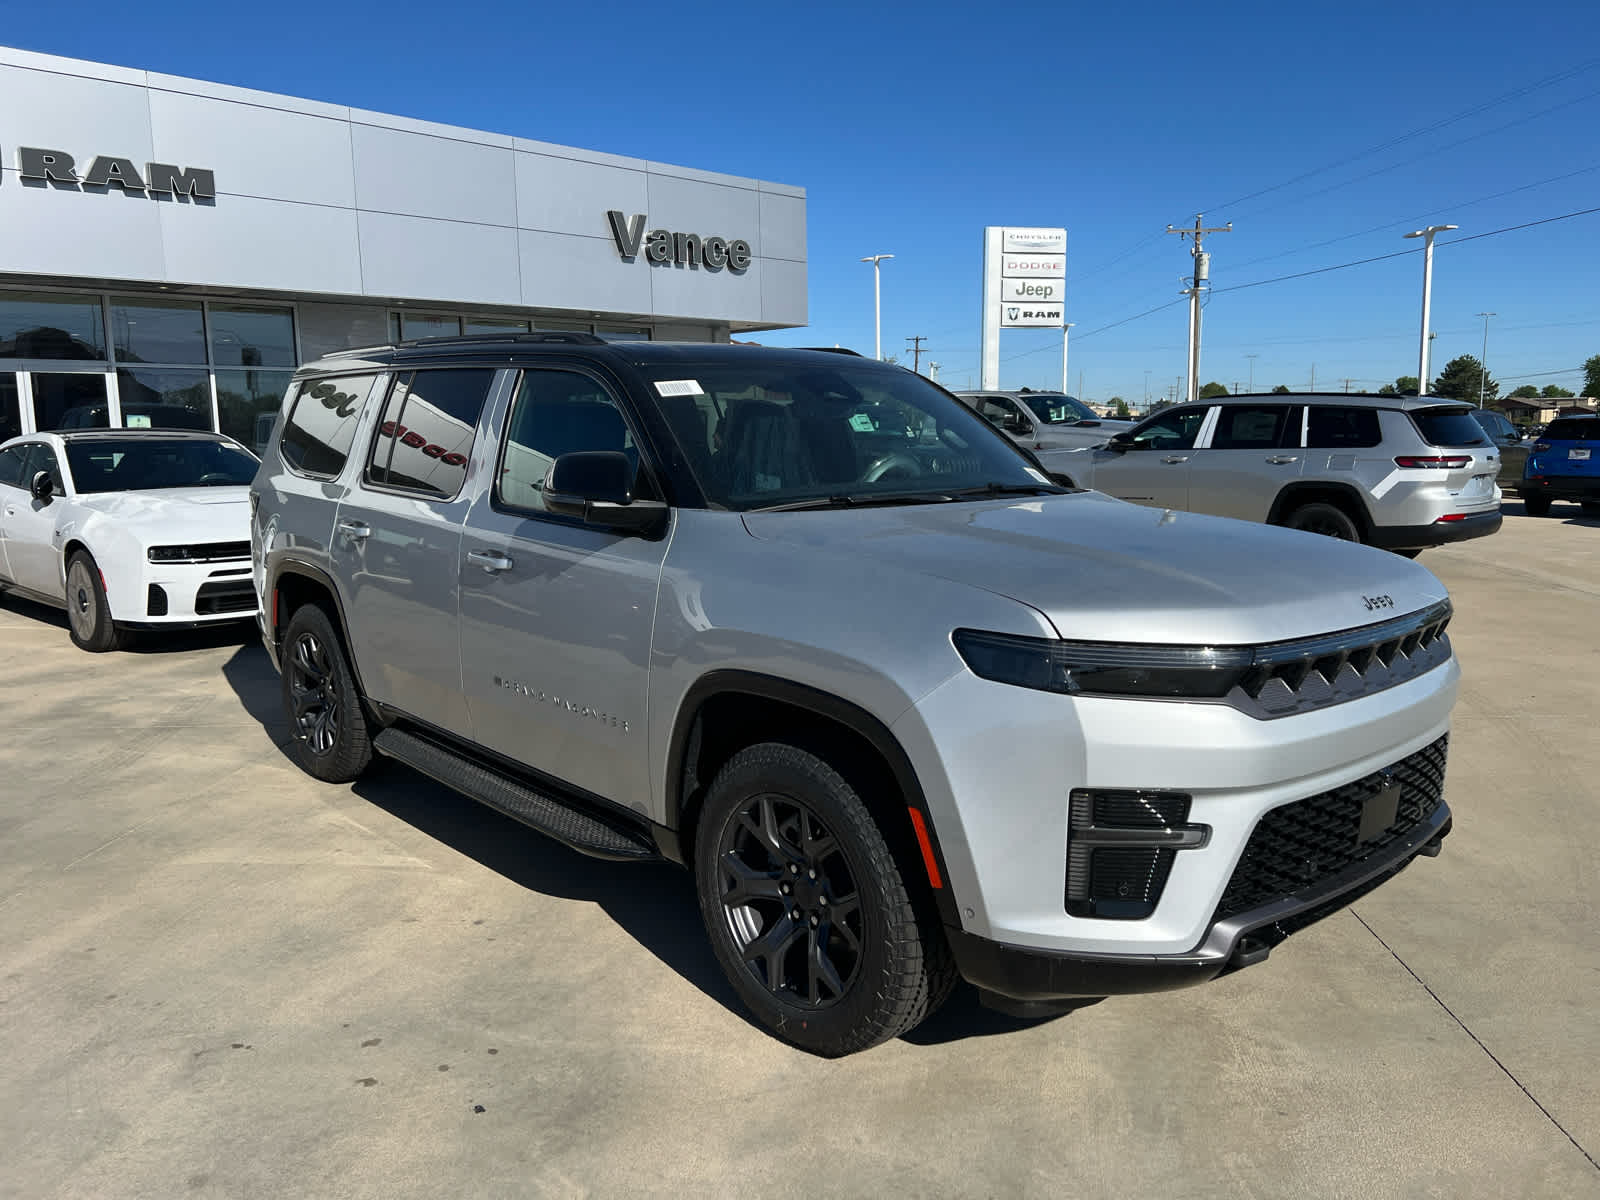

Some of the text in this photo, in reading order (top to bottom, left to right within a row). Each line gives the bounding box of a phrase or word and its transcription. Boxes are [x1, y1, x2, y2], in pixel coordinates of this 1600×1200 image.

[17, 146, 216, 200] RAM
[607, 210, 752, 272] Vance
[1007, 261, 1063, 270] DODGE
[1016, 281, 1053, 299] Jeep
[1022, 311, 1060, 319] RAM
[1362, 594, 1395, 611] Jeep
